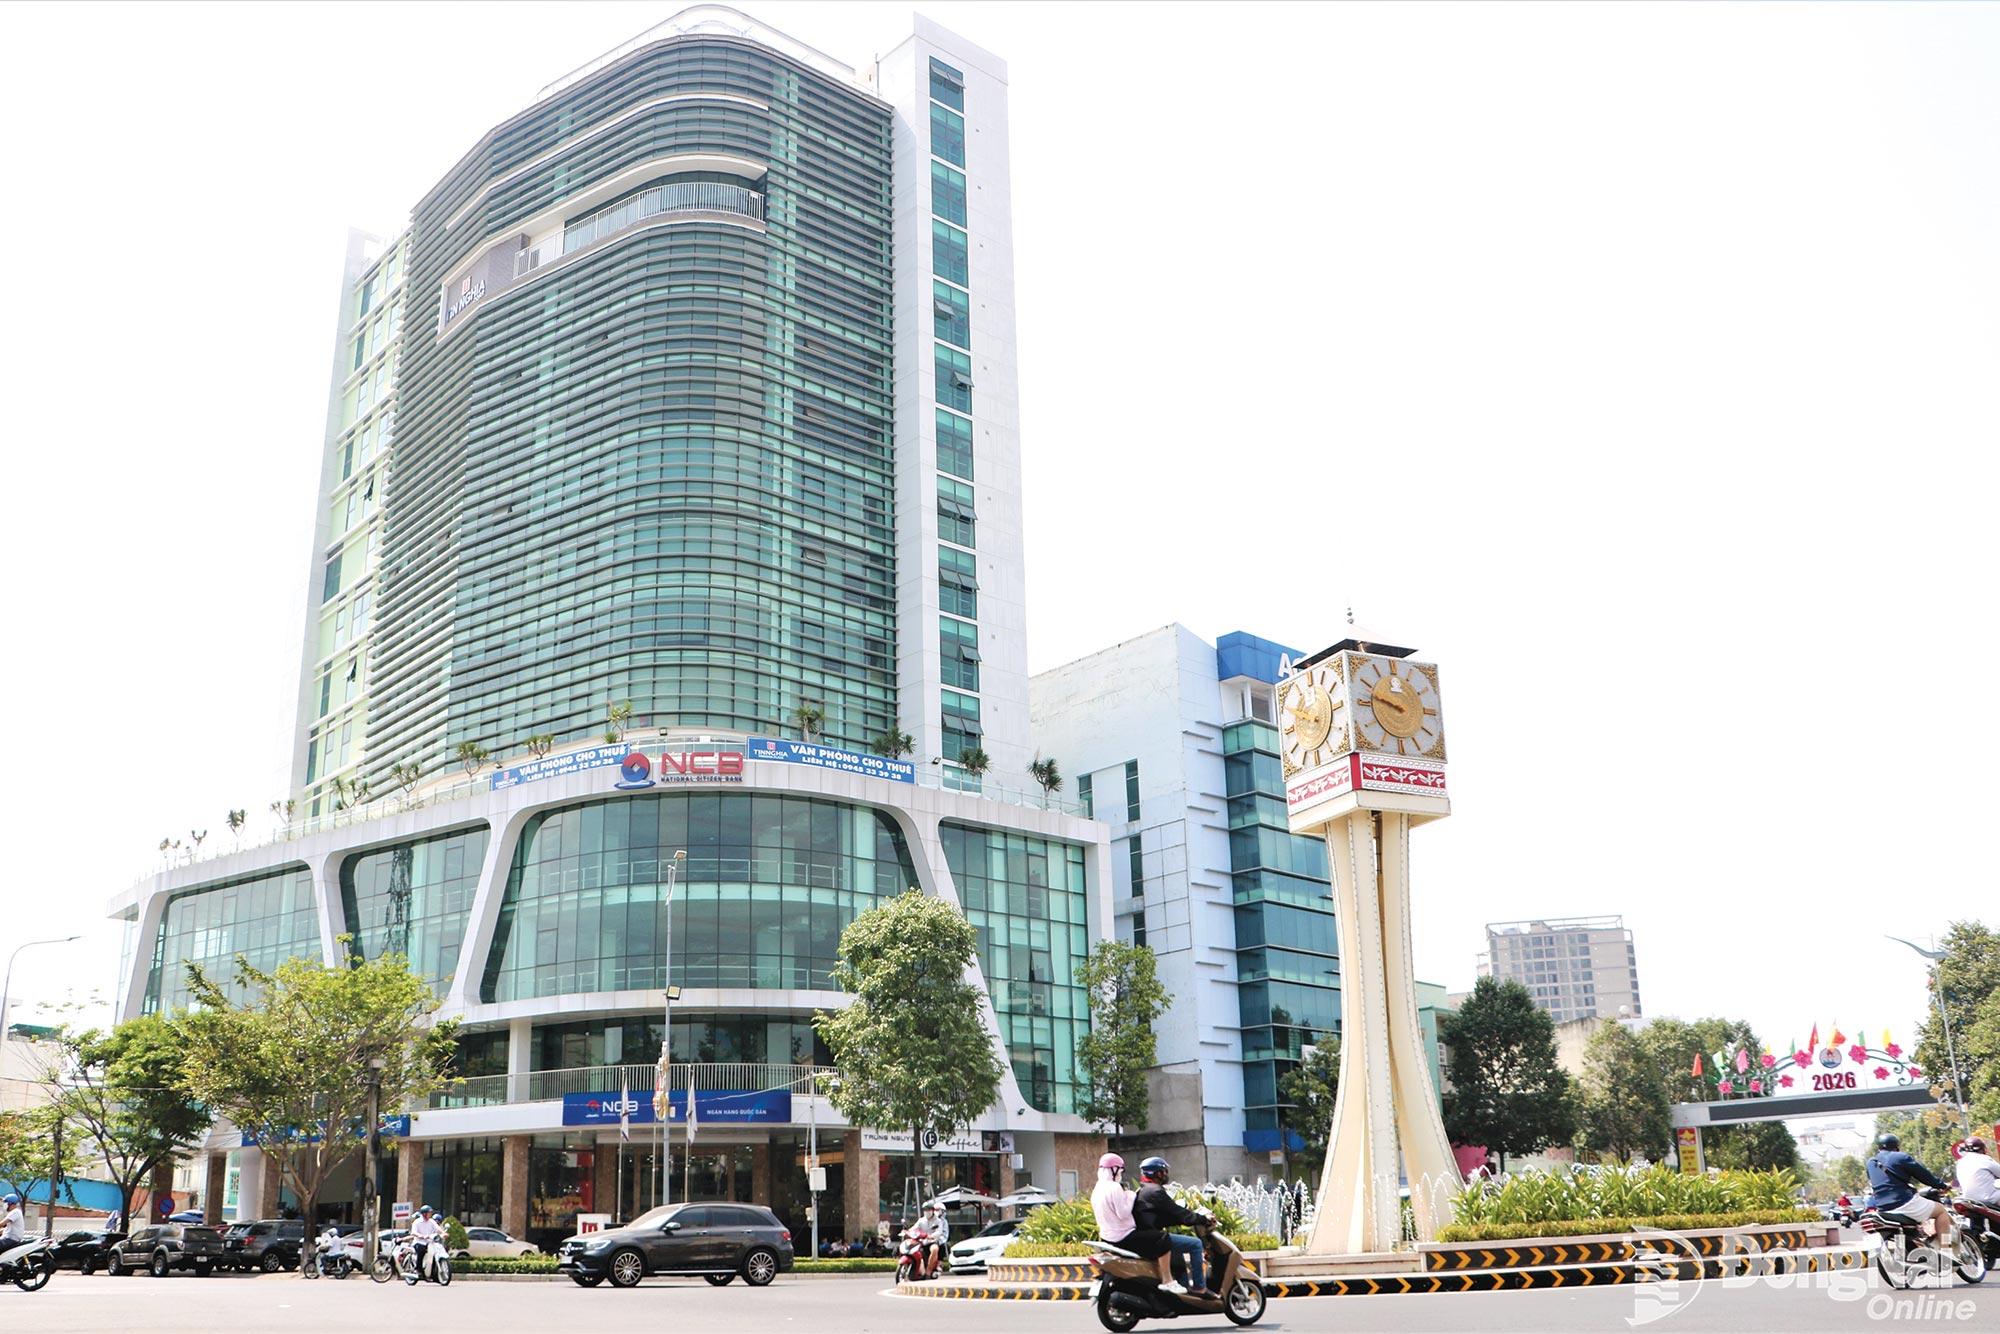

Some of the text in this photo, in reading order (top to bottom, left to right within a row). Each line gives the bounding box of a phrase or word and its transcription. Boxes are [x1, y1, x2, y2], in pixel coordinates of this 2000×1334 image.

[575, 750, 596, 761] CHO
[661, 751, 744, 775] NCB
[862, 756, 883, 769] CHO
[1812, 1071, 1857, 1091] 2026
